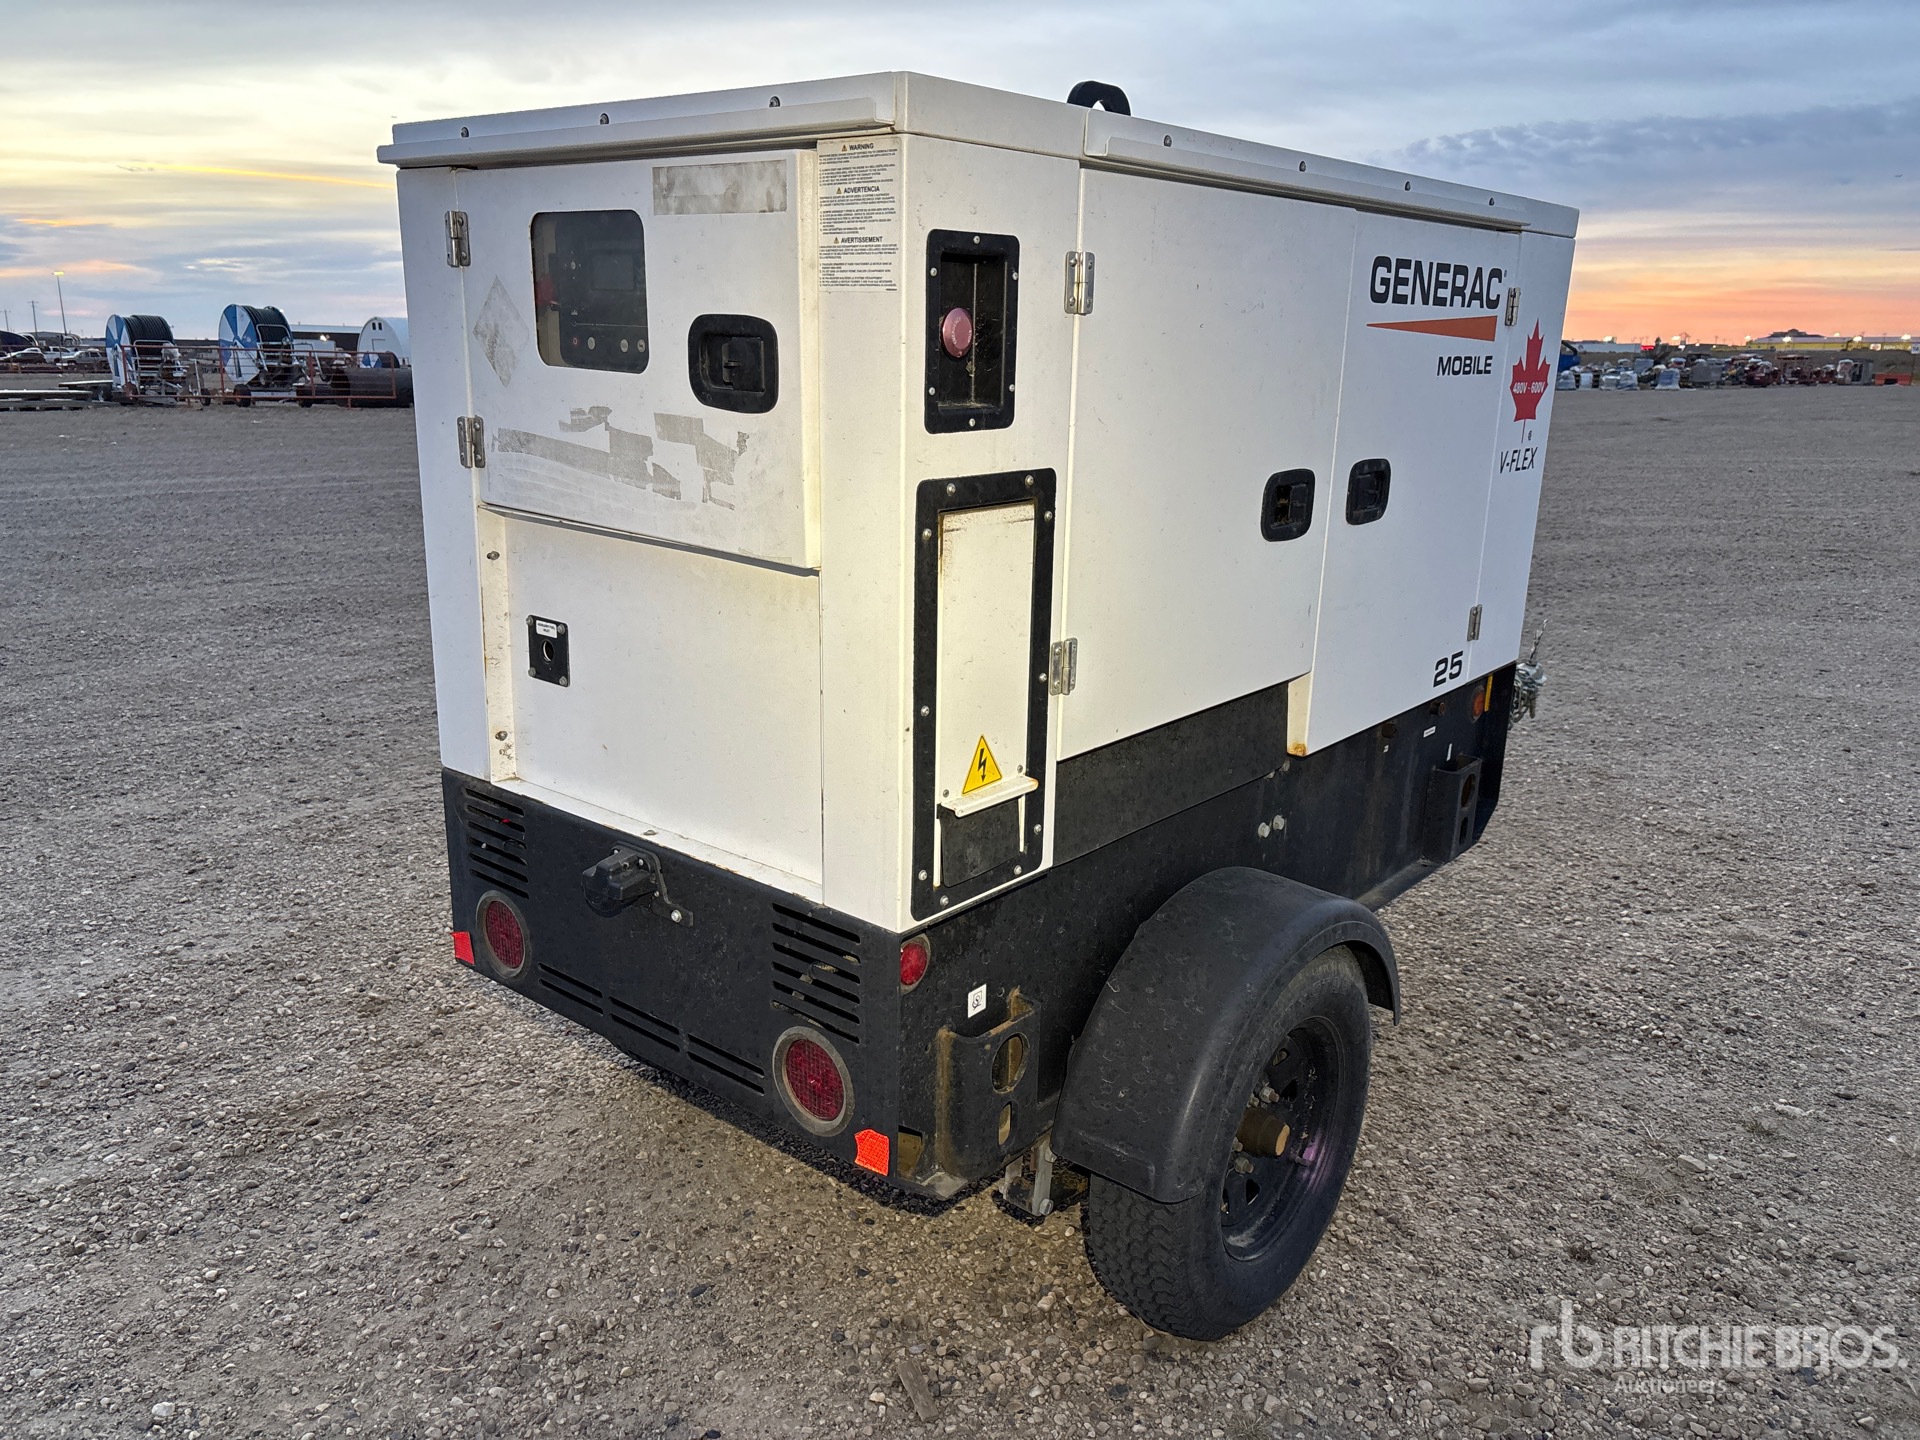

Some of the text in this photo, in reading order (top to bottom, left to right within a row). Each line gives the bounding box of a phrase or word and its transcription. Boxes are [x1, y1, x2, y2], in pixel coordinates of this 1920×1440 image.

[849, 142, 874, 151] WARNING
[843, 185, 880, 194] ADVERTENCIA
[840, 236, 883, 244] AVERTISSEMENT
[1369, 255, 1503, 310] GENERAC
[1436, 355, 1493, 376] MOBILE
[1499, 446, 1539, 474] V-FLEX
[1432, 650, 1464, 688] 25
